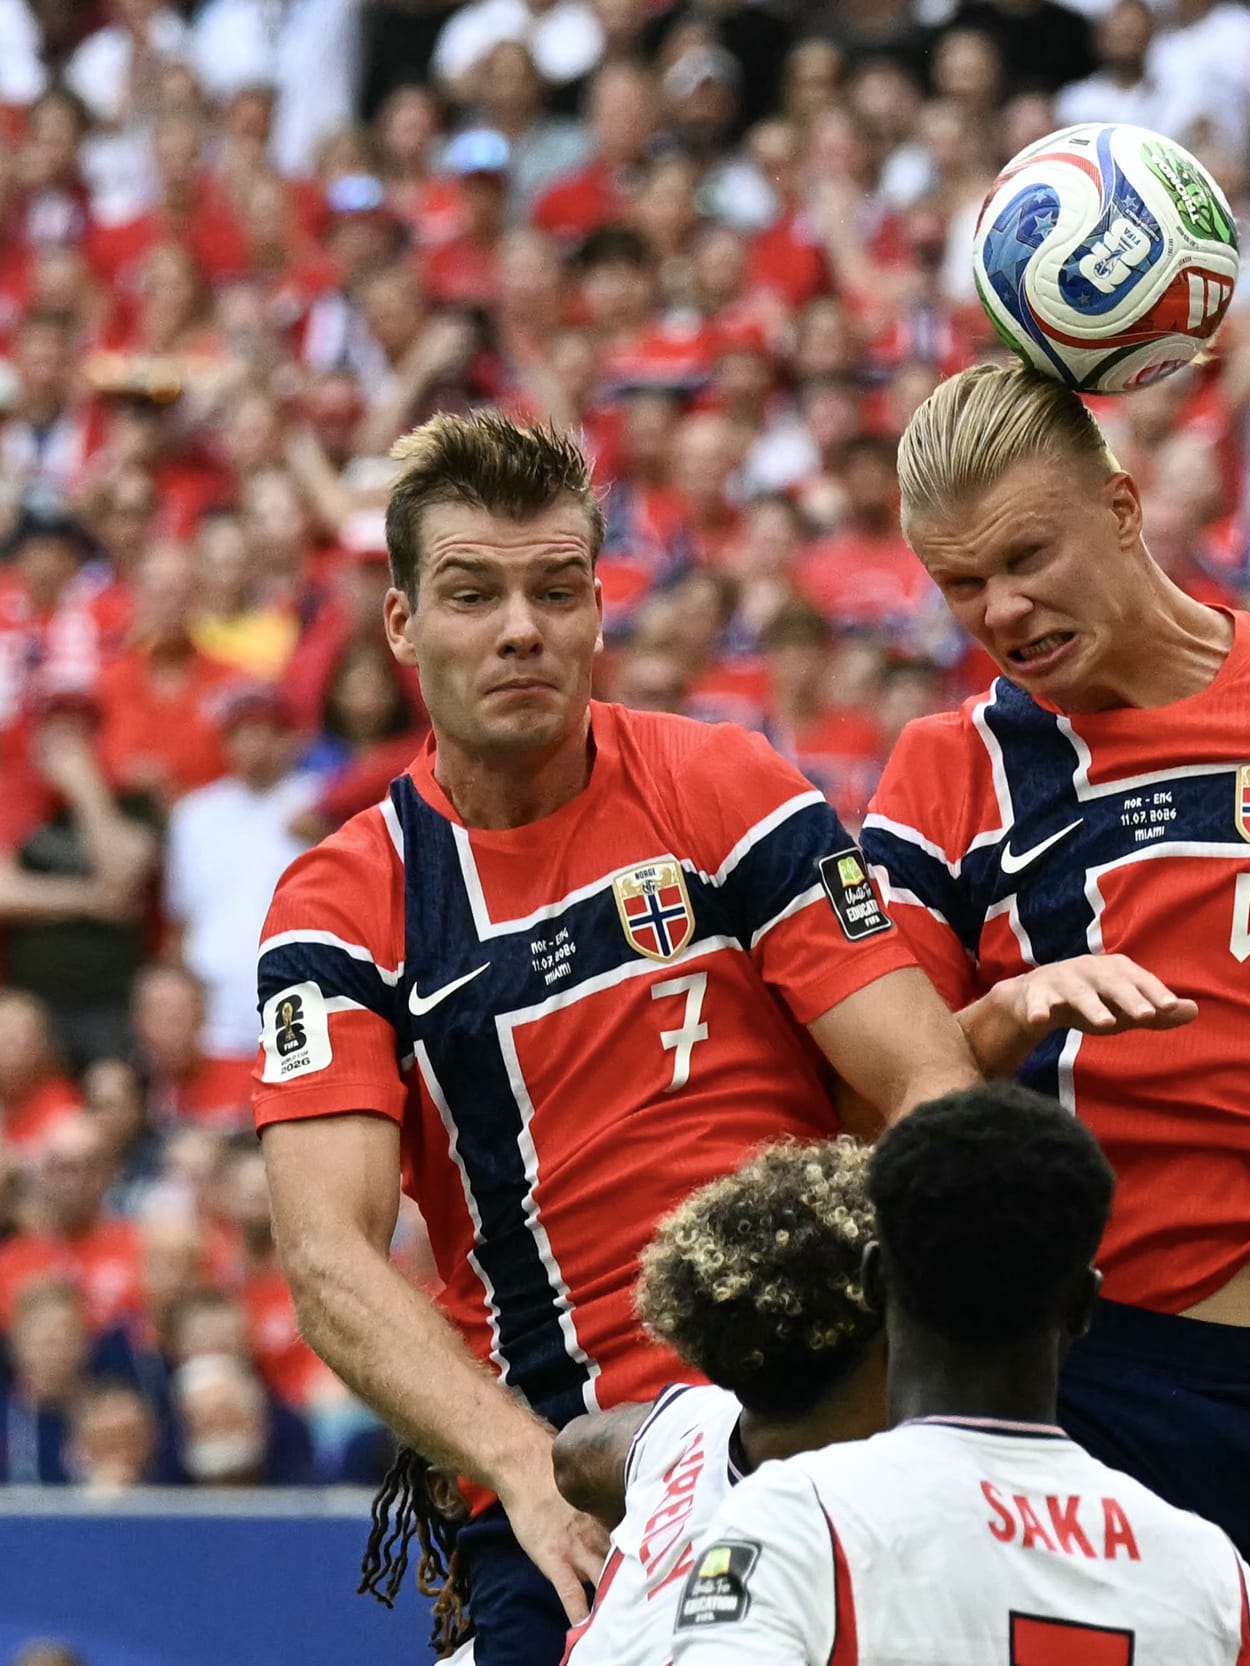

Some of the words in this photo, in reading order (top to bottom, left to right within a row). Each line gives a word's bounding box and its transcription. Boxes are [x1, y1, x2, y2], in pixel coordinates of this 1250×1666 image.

[1151, 152, 1199, 224] TRIONDA
[1123, 226, 1141, 247] FIFA
[1124, 797, 1142, 810] NOR
[1153, 791, 1172, 805] ENG
[1135, 826, 1165, 842] MIAMI
[635, 868, 656, 880] NORGE
[531, 940, 547, 955] NOR
[545, 962, 571, 986] MIAMI
[651, 971, 709, 1092] 7
[283, 1039, 300, 1051] FIFA
[281, 1057, 311, 1075] 2026
[980, 1480, 1141, 1561] SAKA
